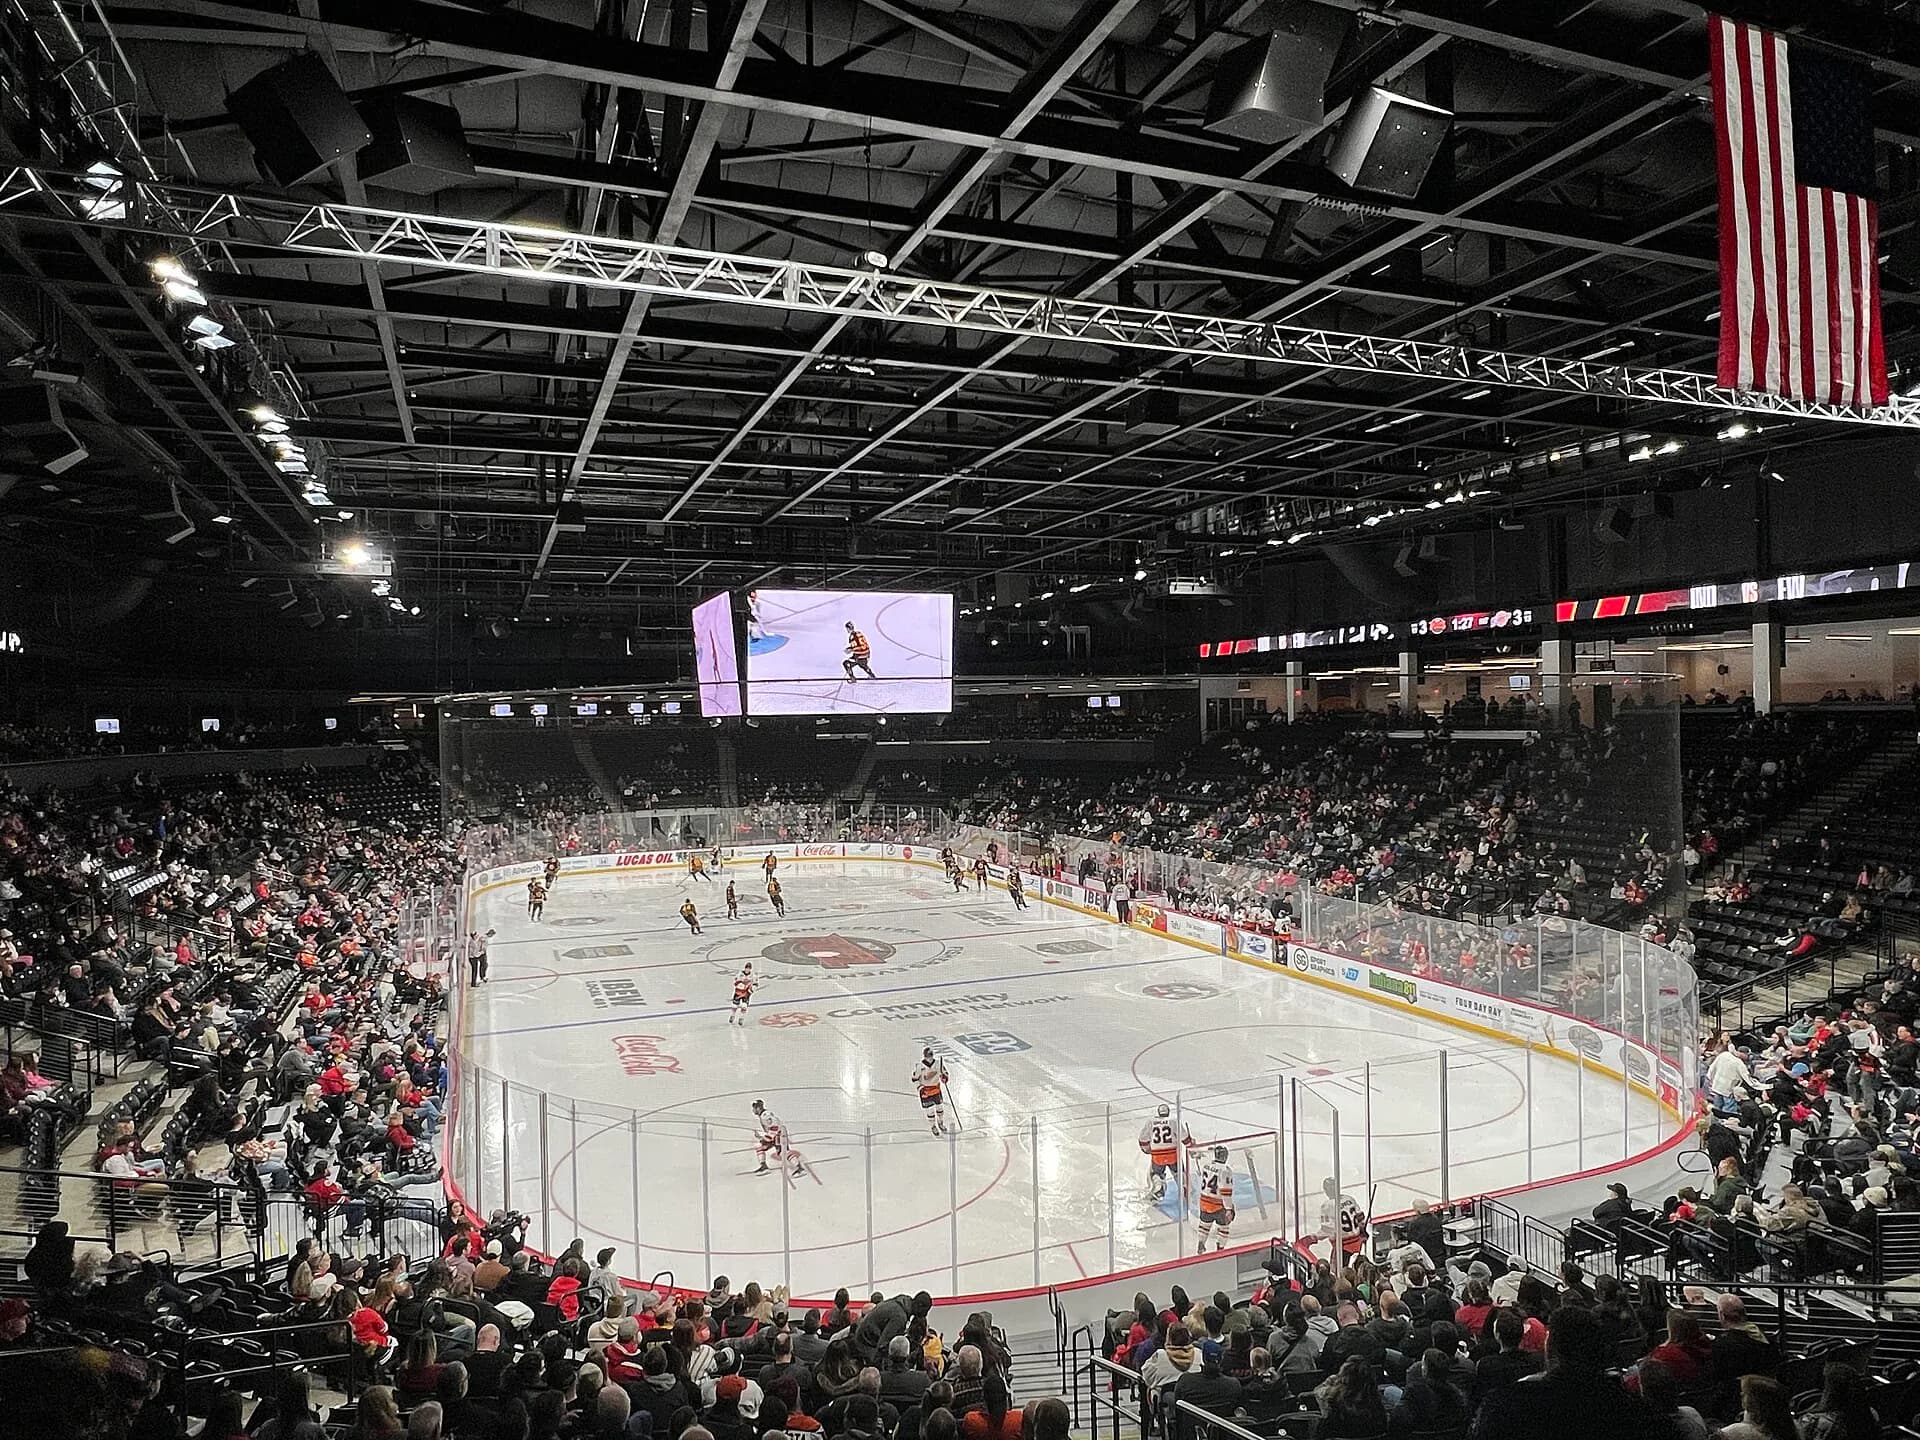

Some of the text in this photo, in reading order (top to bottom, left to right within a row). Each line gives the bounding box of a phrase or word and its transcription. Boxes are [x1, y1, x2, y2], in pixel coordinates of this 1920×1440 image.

[1742, 583, 1758, 603] VS
[1777, 575, 1805, 600] FW
[1419, 620, 1427, 634] 3
[1452, 617, 1473, 630] 1:27
[1513, 609, 1522, 625] 3
[616, 853, 673, 866] LUCAS OIL
[1296, 953, 1307, 967] SG
[1310, 956, 1326, 966] SPORT
[1310, 964, 1335, 976] GRAPHICS
[600, 979, 648, 1006] IBEW
[827, 993, 1009, 1018] Community
[884, 995, 1075, 1021] Health Network
[1456, 997, 1472, 1008] FOUR
[1474, 1002, 1486, 1014] DAY
[1489, 1006, 1501, 1017] RAY
[963, 1033, 1022, 1053] PPG
[1152, 1126, 1173, 1144] 32
